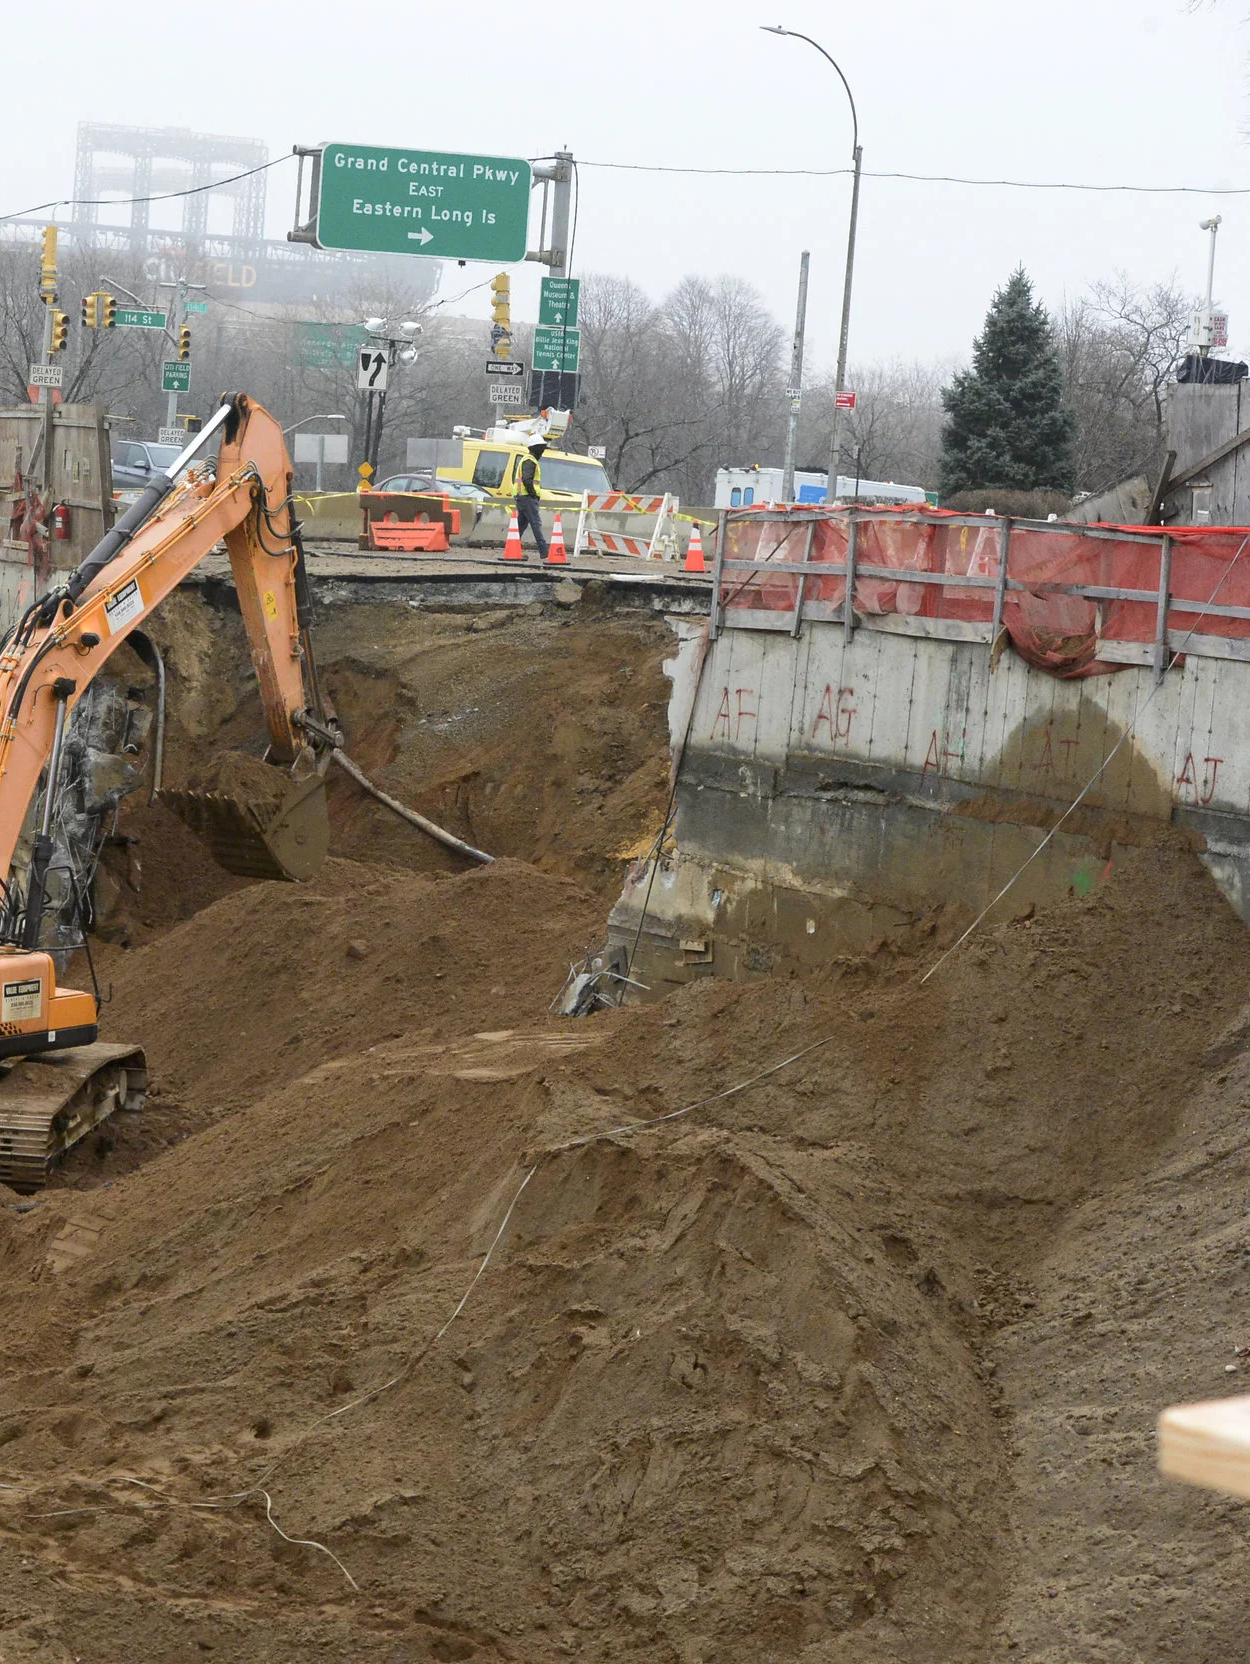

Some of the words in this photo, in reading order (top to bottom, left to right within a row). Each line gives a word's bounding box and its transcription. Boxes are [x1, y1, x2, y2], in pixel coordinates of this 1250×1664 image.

[334, 152, 389, 172] Grand
[397, 158, 464, 178] Central
[473, 164, 520, 185] Pkwy
[409, 182, 444, 198] EAST
[353, 199, 422, 218] Eastern
[431, 205, 472, 227] Long
[482, 209, 496, 224] Is
[543, 291, 568, 299] Museum
[125, 314, 138, 323] 114
[142, 315, 152, 324] St
[536, 350, 555, 358] Tennis
[32, 367, 62, 376] DELAYED
[164, 363, 175, 371] CITI
[175, 364, 190, 372] FIELD
[32, 375, 60, 384] GREEN
[165, 371, 188, 379] PARKING
[491, 386, 520, 394] DELAYED
[492, 394, 519, 402] GREEN
[710, 687, 756, 741] AF
[812, 683, 857, 750] AG
[1176, 752, 1224, 807] AJ
